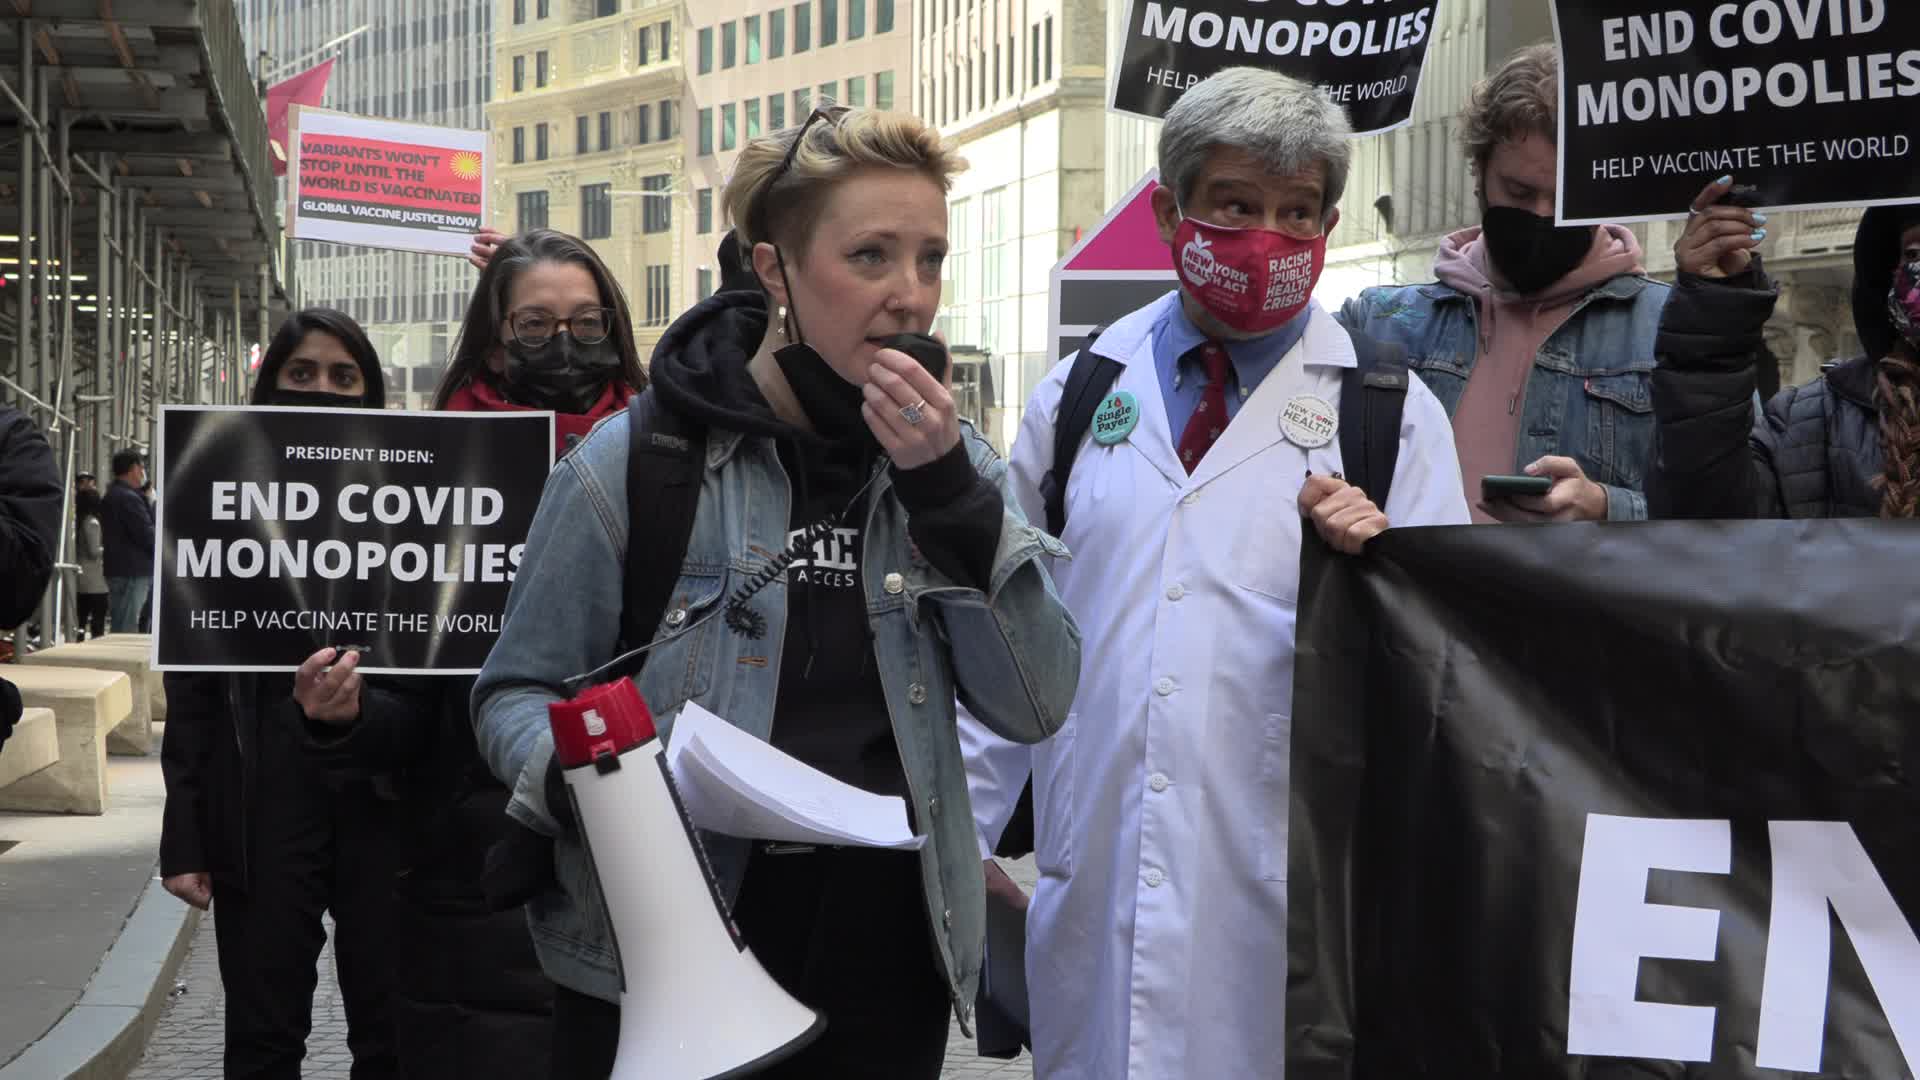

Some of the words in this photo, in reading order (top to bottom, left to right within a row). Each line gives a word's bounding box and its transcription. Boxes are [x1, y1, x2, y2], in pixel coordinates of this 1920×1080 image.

[1142, 2, 1430, 57] MONOPOLIES
[1602, 10, 1695, 62] END
[1709, 0, 1886, 48] COVID
[1147, 66, 1199, 91] HELP
[1319, 82, 1353, 103] THE
[1357, 74, 1408, 101] WORLD
[1577, 49, 1920, 126] MONOPOLIES
[301, 142, 382, 161] VARIANTS
[385, 151, 440, 168] WON'T
[1592, 156, 1644, 180] HELP
[1650, 146, 1761, 175] VACCINATE
[1767, 142, 1817, 166] THE
[1823, 135, 1910, 161] WORLD
[301, 158, 342, 173] STOP
[344, 163, 392, 179] UNTIL
[395, 168, 424, 182] THE
[300, 175, 361, 193] WORLD
[364, 182, 377, 194] IS
[381, 183, 481, 205] VACCINATED
[302, 200, 350, 215] GLOBAL
[351, 205, 402, 220] VACCINE
[401, 211, 445, 225] JUSTICE
[446, 215, 477, 228] NOW
[1186, 248, 1212, 269] NEW
[1215, 262, 1248, 284] YORK
[1269, 249, 1312, 273] RACISM
[1273, 263, 1312, 285] PUBLIC
[1224, 279, 1247, 294] ACT
[1266, 275, 1311, 299] HEALTH
[1097, 406, 1132, 423] Single
[1288, 402, 1309, 415] NEW
[1096, 416, 1130, 433] Payer
[1284, 409, 1332, 437] HEALTH
[285, 446, 374, 463] PRESIDENT
[379, 448, 434, 464] BIDEN:
[211, 481, 320, 522] END
[337, 483, 504, 526] COVID
[176, 538, 526, 583] MONOPOLIES
[190, 610, 246, 630] HELP
[252, 610, 377, 632] VACCINATE
[384, 612, 428, 633] THE
